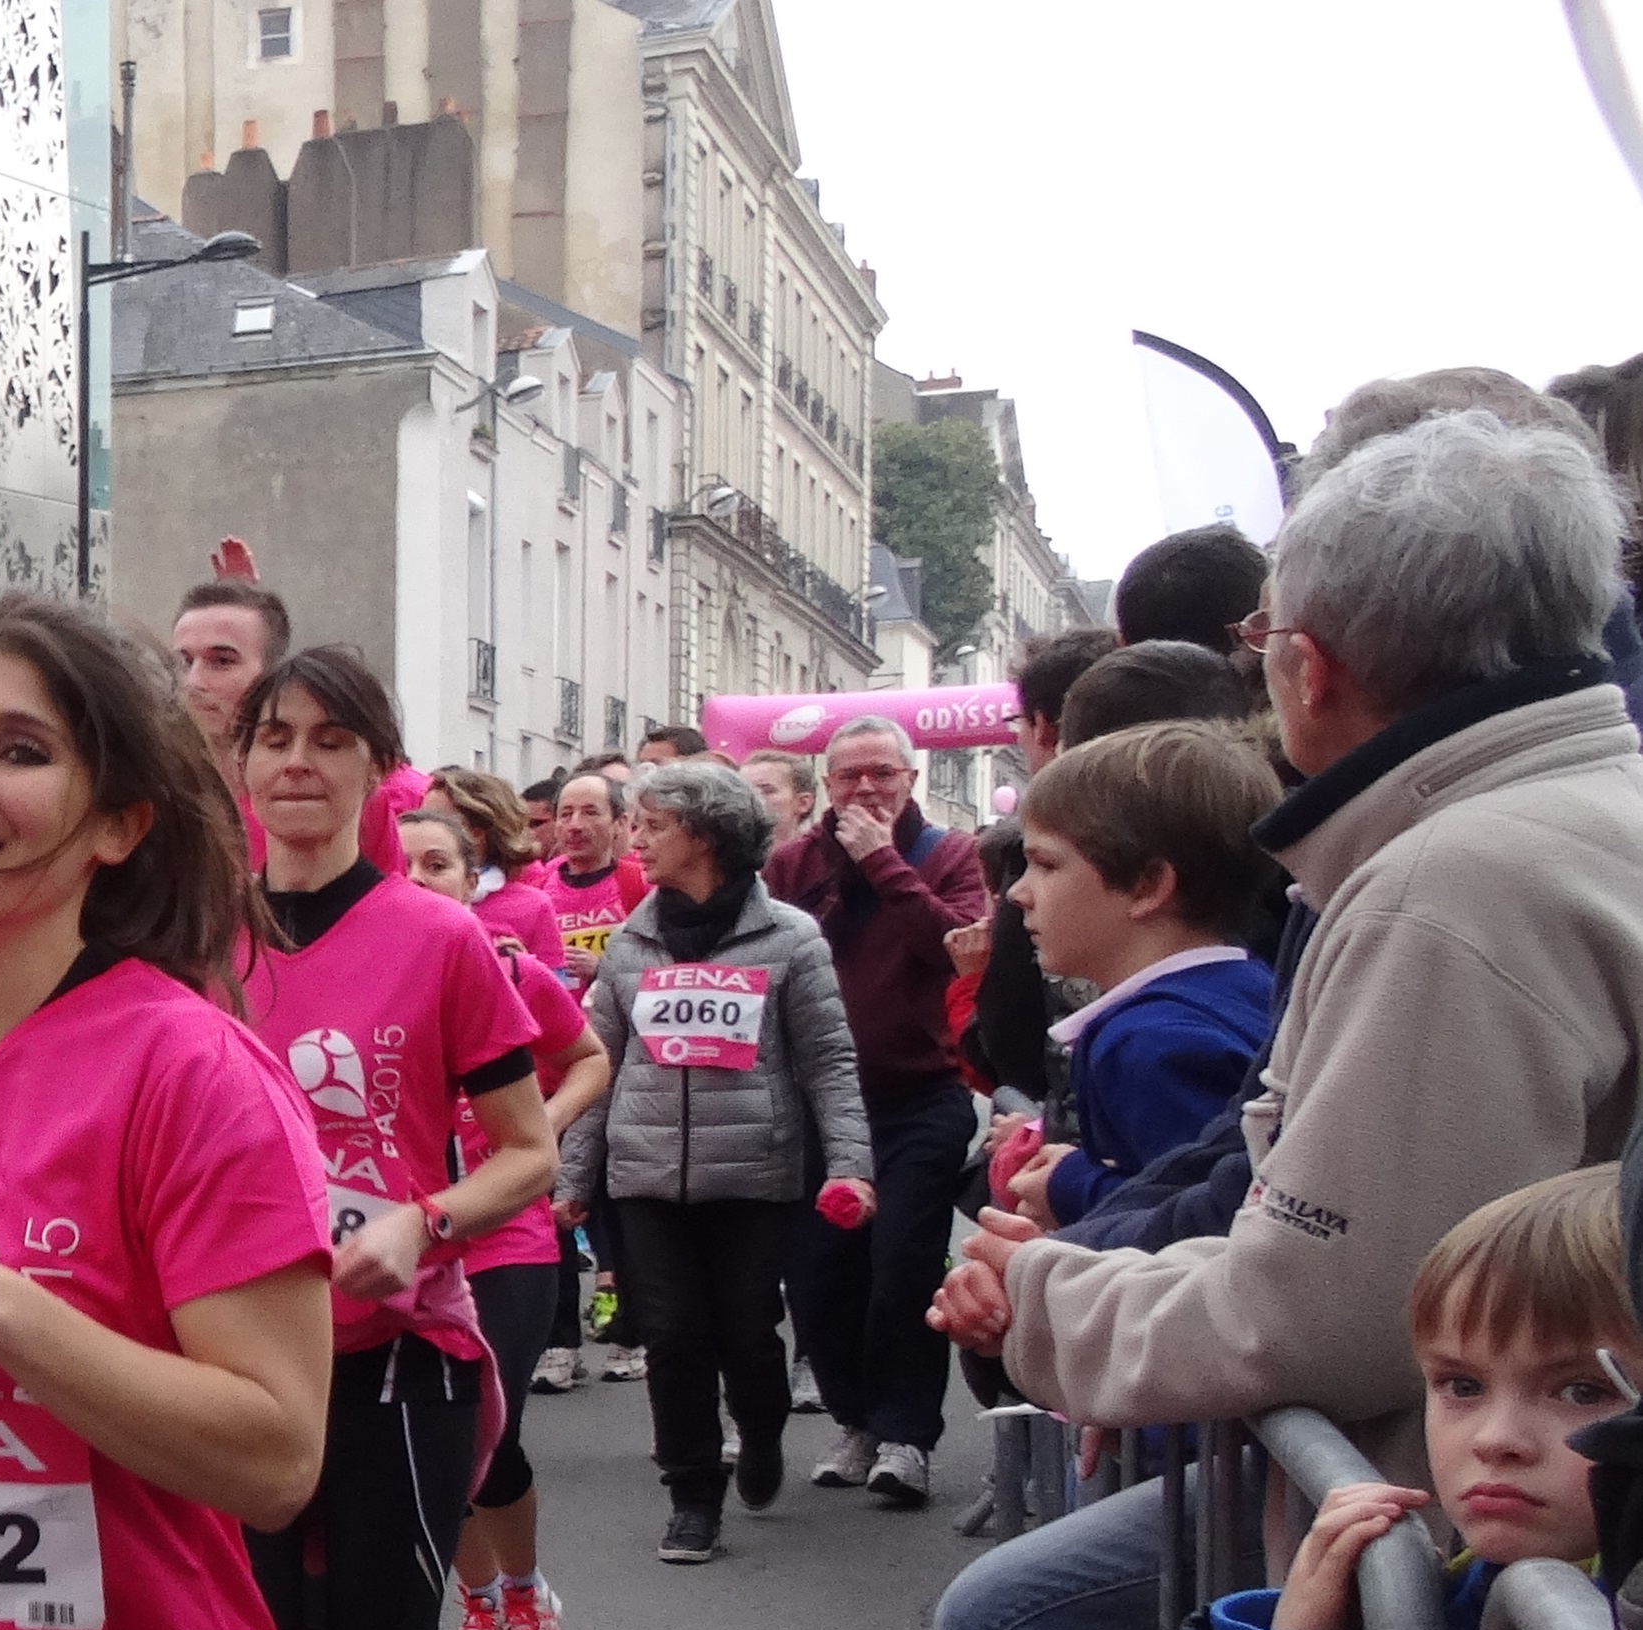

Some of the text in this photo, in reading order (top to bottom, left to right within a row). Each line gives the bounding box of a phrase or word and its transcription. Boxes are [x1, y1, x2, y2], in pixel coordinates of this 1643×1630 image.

[916, 694, 1015, 732] ODYSSE
[655, 968, 752, 992] TENA
[650, 998, 741, 1027] 2060
[323, 1148, 389, 1193] NA
